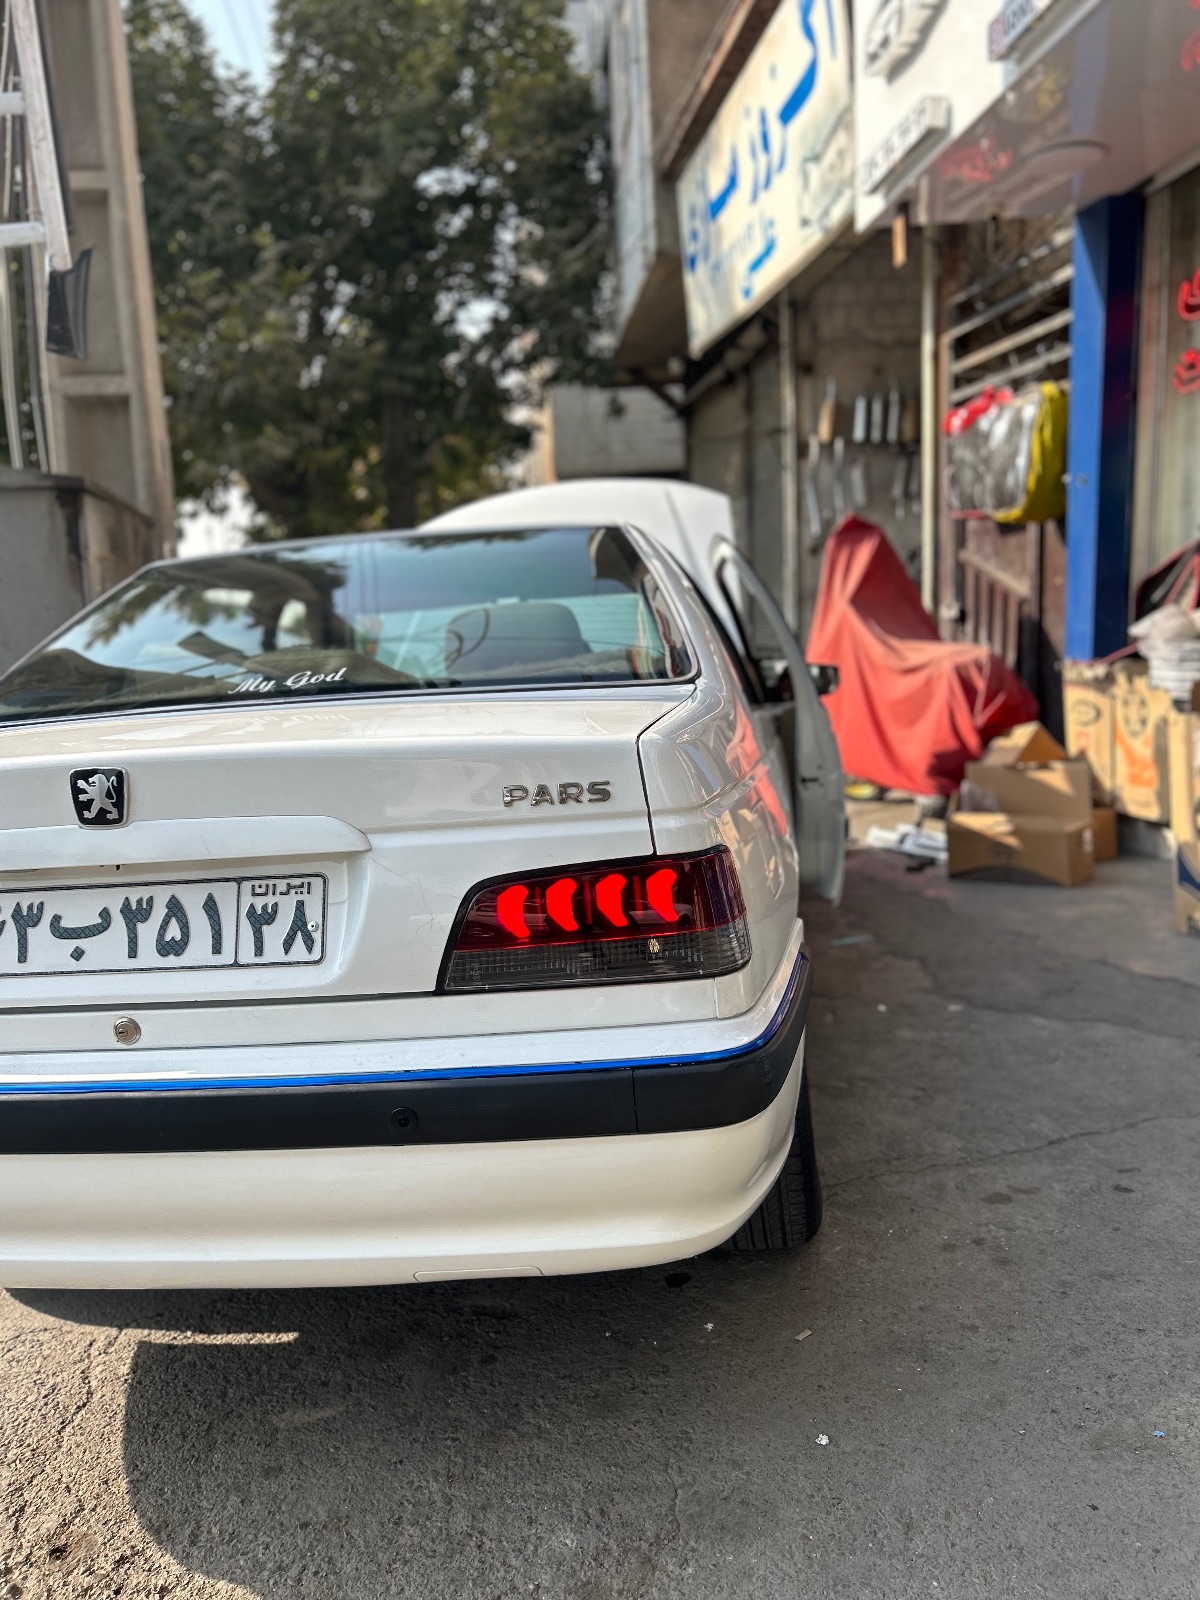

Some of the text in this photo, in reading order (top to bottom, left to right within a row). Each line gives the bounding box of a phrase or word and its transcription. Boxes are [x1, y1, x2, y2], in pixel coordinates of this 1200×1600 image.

[227, 667, 348, 694] My God
[502, 780, 612, 807] PARS
[251, 881, 312, 897] ایران
[245, 899, 315, 957] ۳۸
